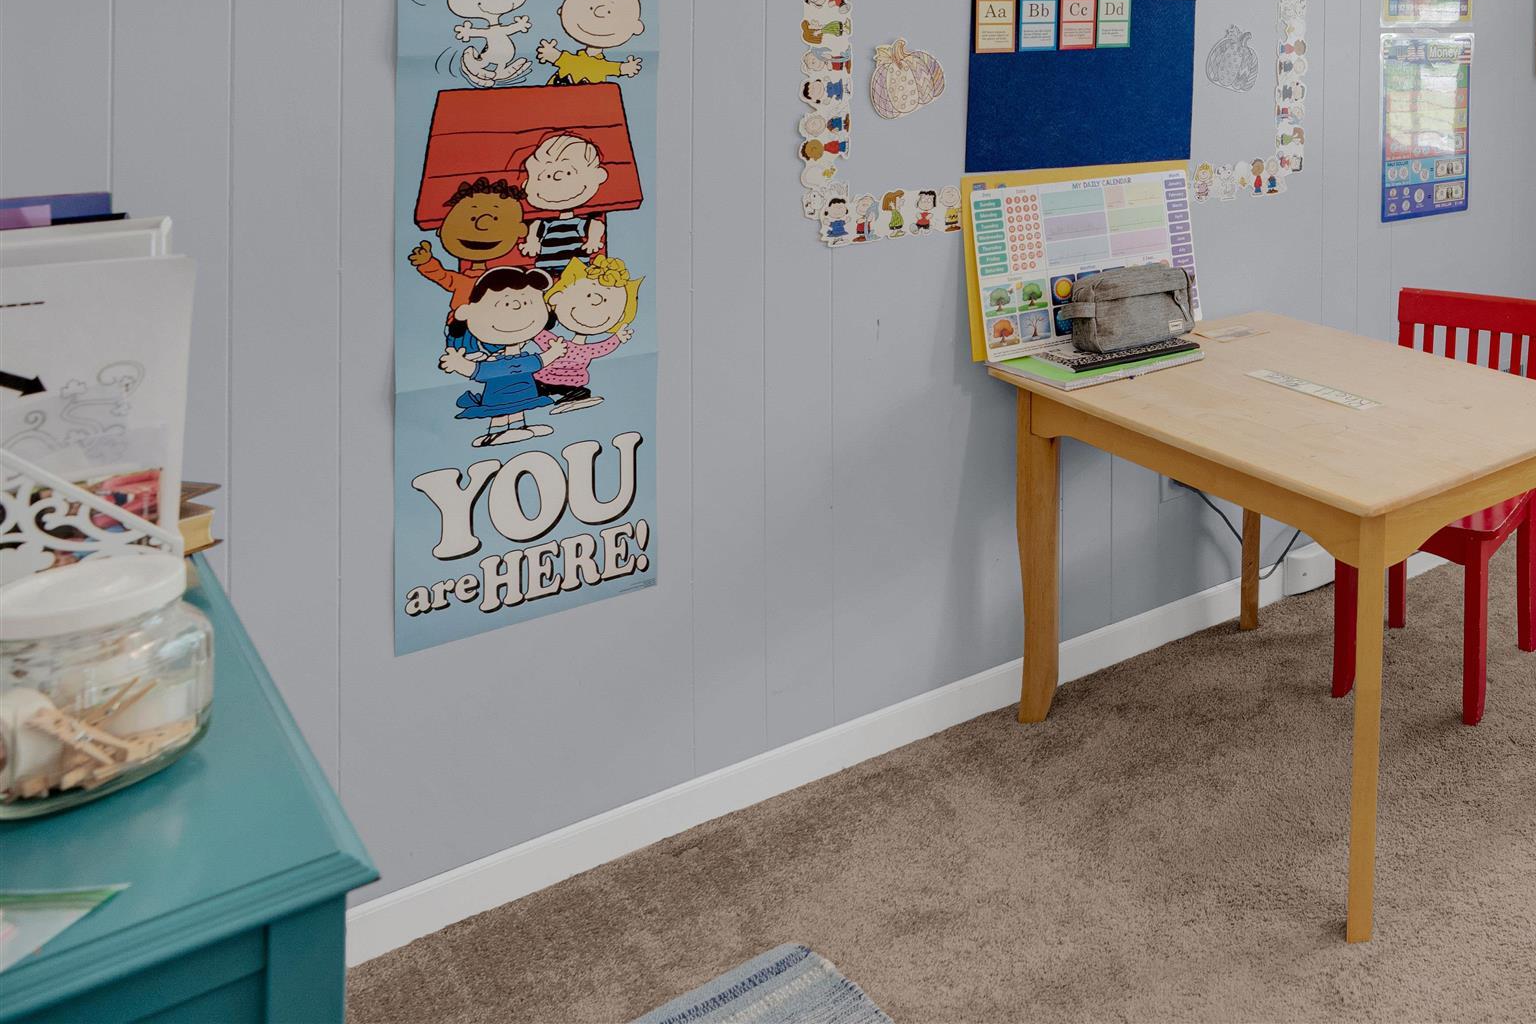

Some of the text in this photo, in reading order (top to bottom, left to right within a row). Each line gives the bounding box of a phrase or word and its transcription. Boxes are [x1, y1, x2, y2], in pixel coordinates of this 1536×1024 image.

[985, 4, 1007, 18] Aa
[1029, 3, 1050, 18] Bb
[1069, 2, 1088, 16] Cc
[1104, 2, 1124, 16] Dd
[411, 431, 644, 561] YOU
[405, 519, 650, 617] are HERE!
